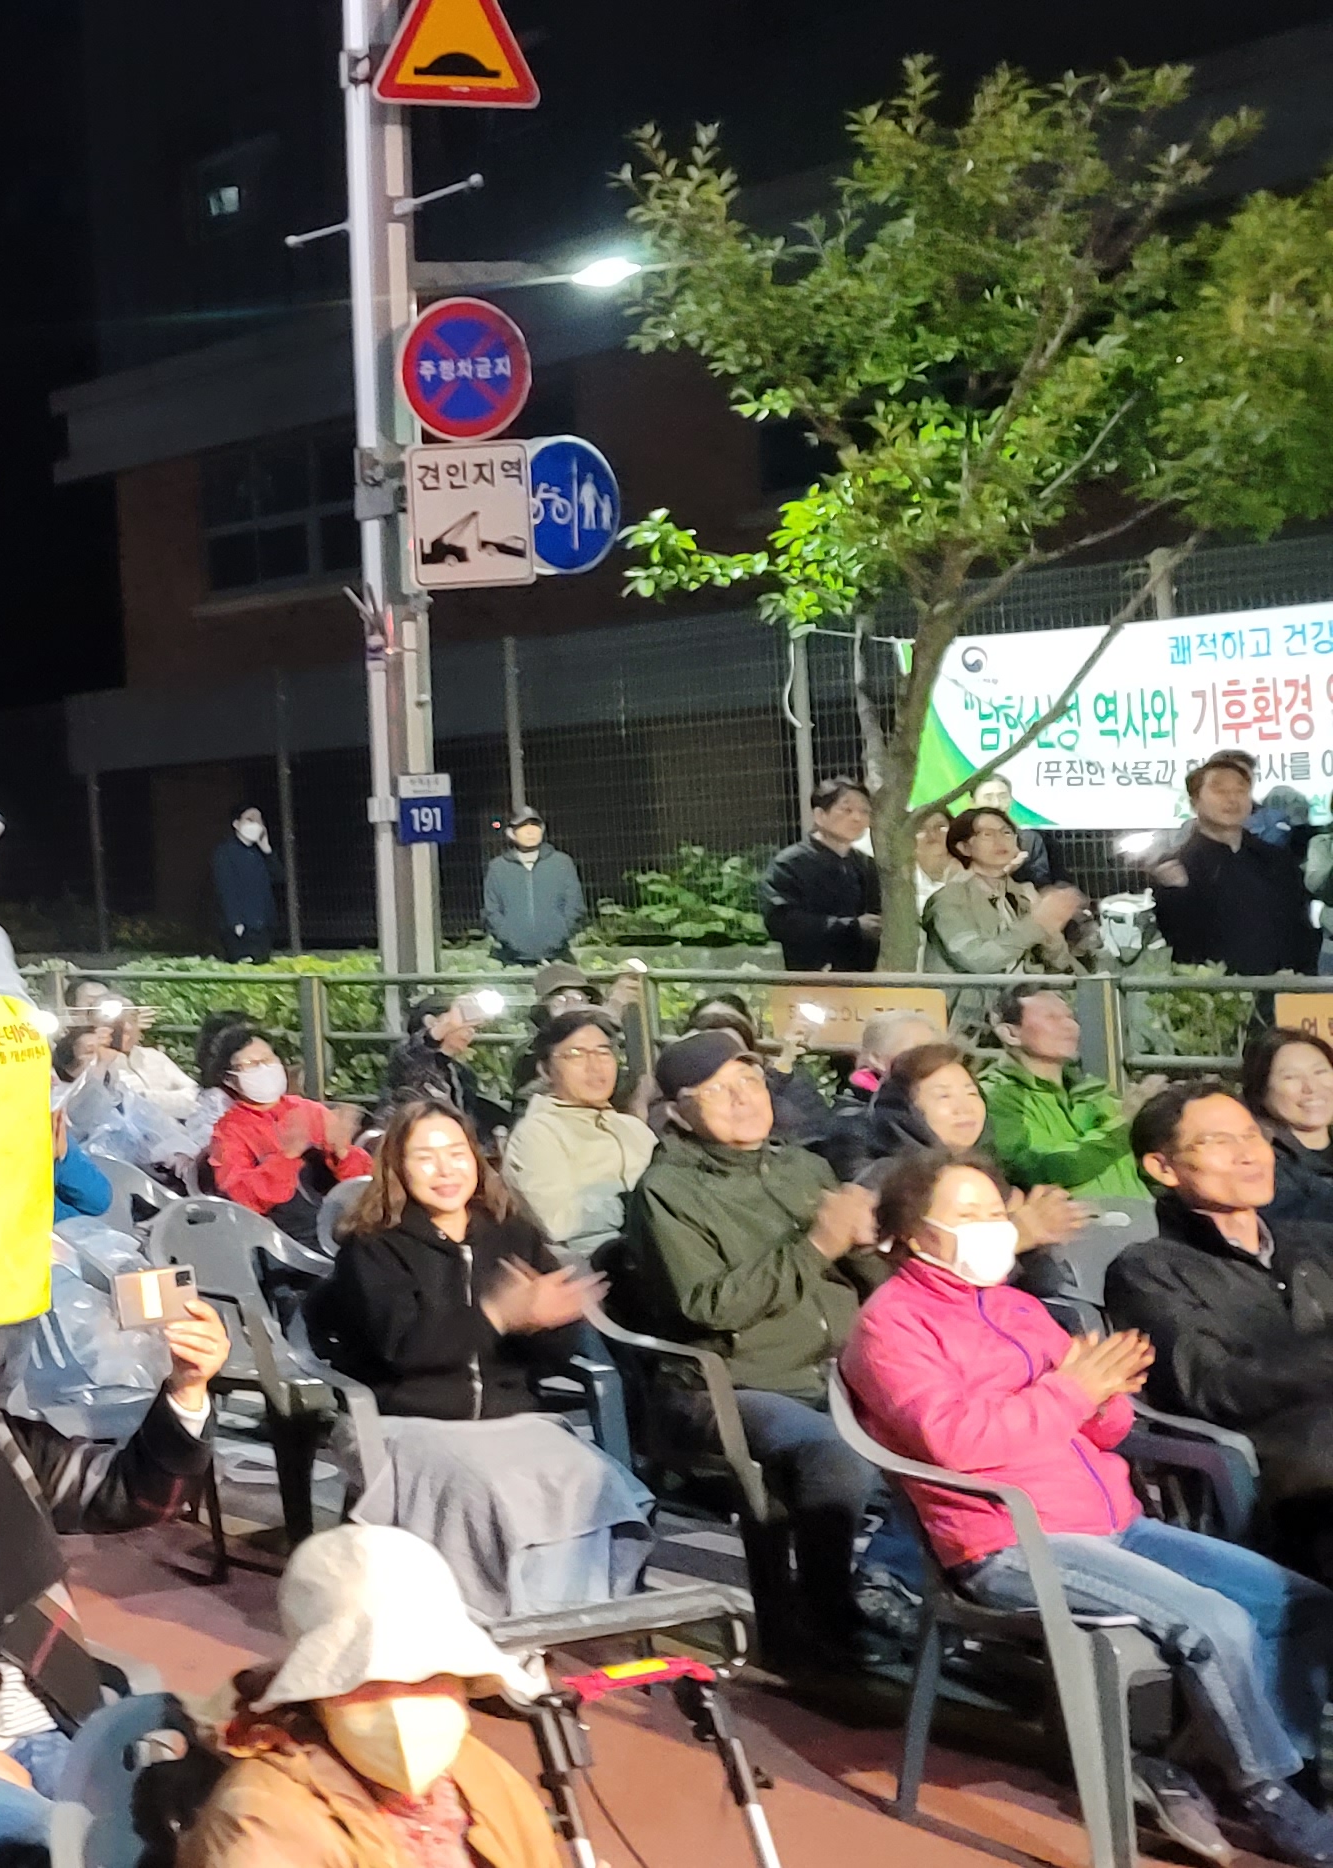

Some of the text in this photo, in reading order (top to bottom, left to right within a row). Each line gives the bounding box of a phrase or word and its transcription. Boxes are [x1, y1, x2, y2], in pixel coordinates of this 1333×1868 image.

[419, 355, 512, 382] 주정차금지
[417, 458, 524, 490] 견인지역
[1168, 628, 1272, 665] 쾌적하고
[1094, 686, 1179, 748] 역사와
[1191, 674, 1315, 744] 기후환경
[1111, 759, 1177, 787] 상품과
[409, 806, 442, 833] 191
